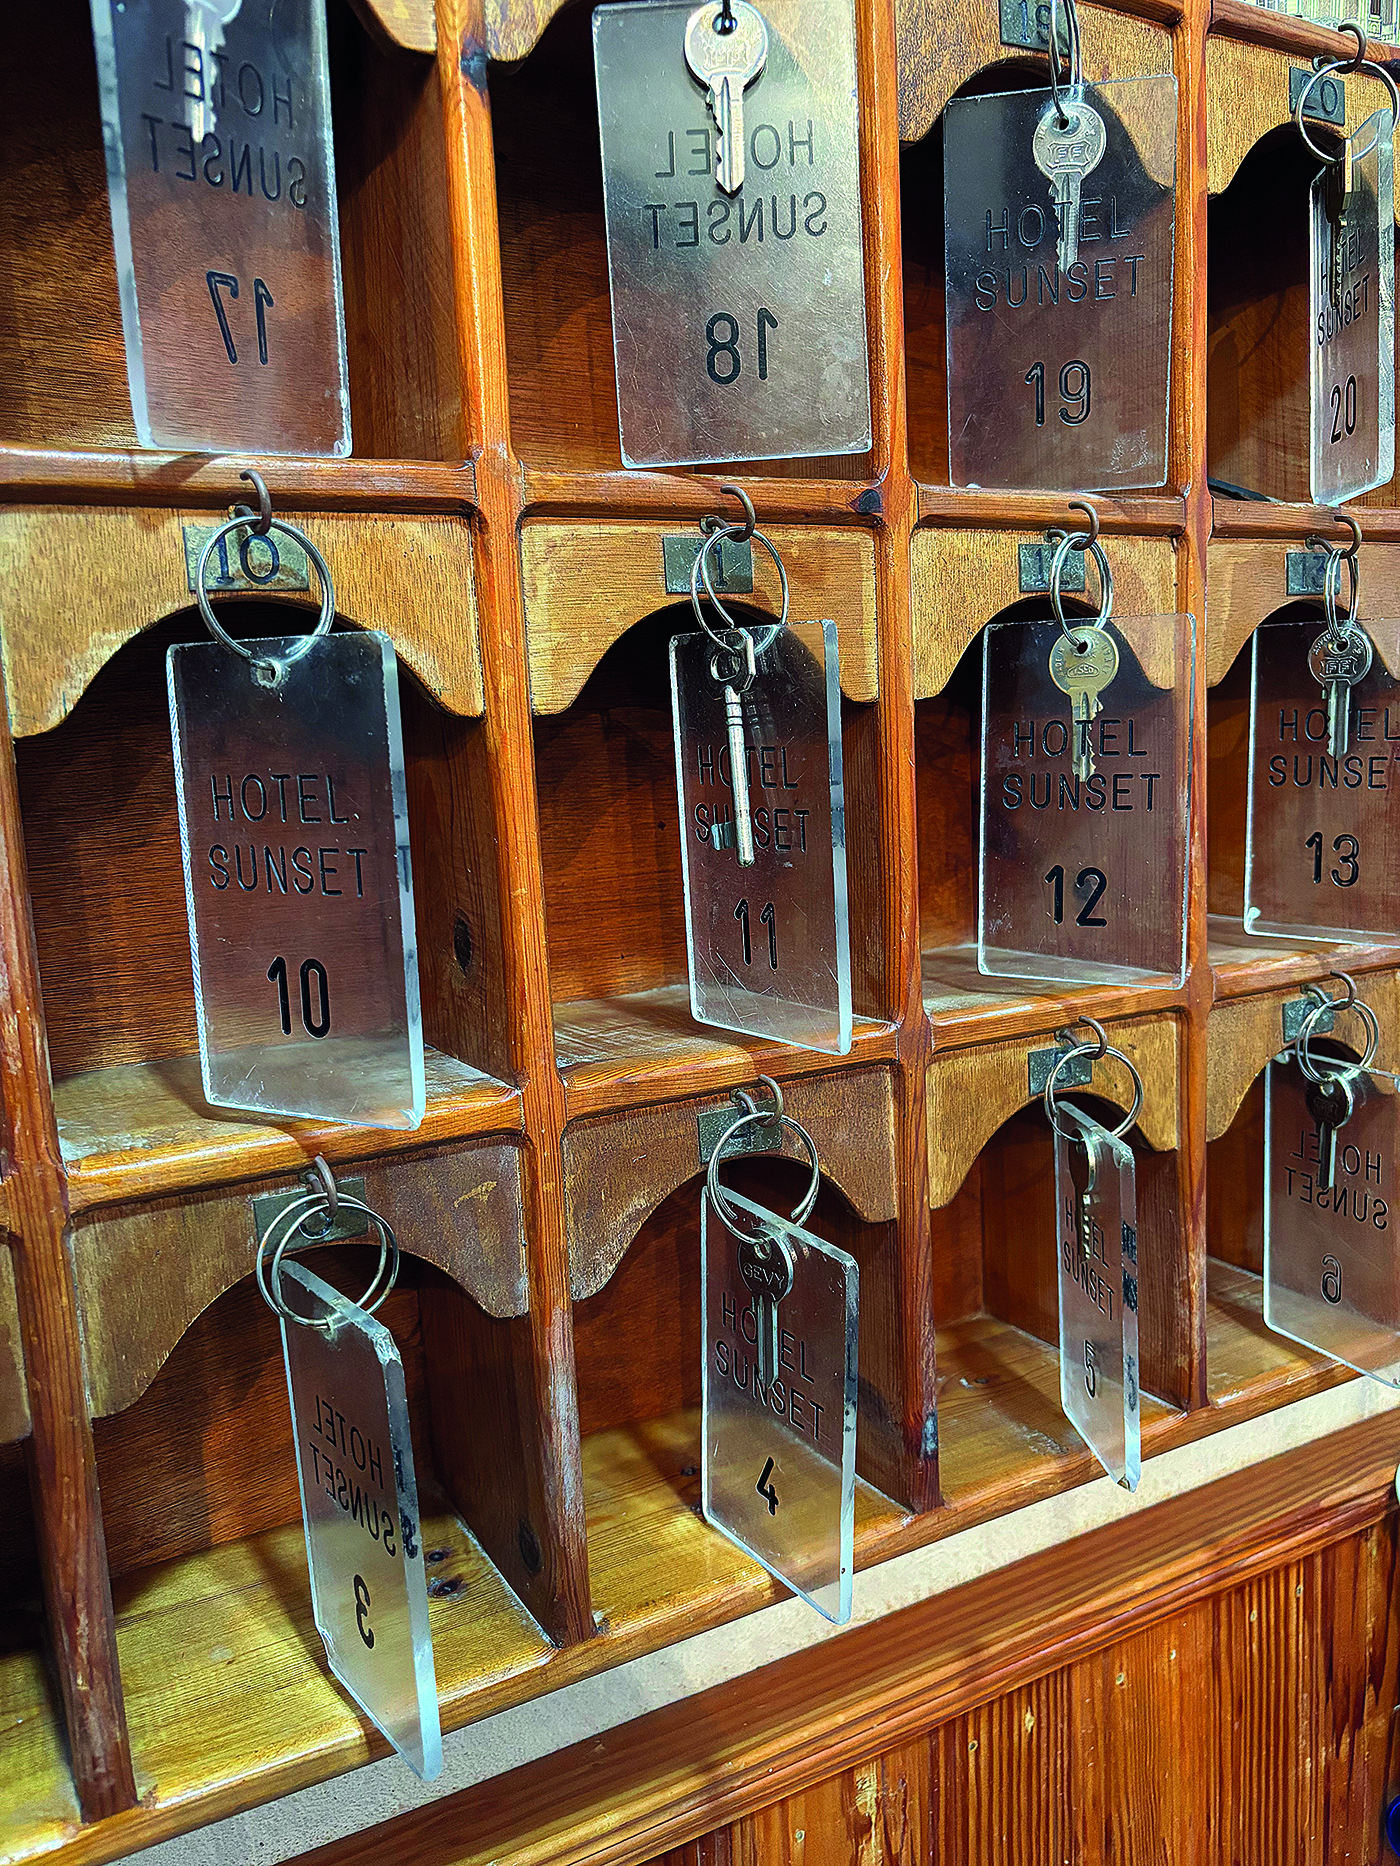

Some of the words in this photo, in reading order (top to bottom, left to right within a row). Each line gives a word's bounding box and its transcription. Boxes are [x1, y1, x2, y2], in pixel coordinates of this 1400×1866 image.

[986, 195, 1131, 252] HOTEL
[975, 254, 1146, 312] SUNSET
[1320, 227, 1366, 296] HTEL
[1317, 273, 1371, 346] SUNSET
[1024, 359, 1092, 427] 19
[1329, 373, 1357, 444] 20
[214, 531, 280, 586] 10
[1013, 718, 1148, 757] HOTEL
[1278, 707, 1400, 742] HOEL
[210, 773, 350, 824] HOTEL
[1002, 772, 1161, 812] SUNSET
[208, 843, 368, 898] SUNSET
[1305, 831, 1360, 888] 13
[1044, 864, 1108, 928] 12
[734, 898, 779, 971] 11
[266, 956, 331, 1039] 10
[1064, 1196, 1110, 1270] HEL
[1063, 1240, 1115, 1322] SUNSET
[721, 1291, 815, 1384] HOEL
[715, 1339, 825, 1441] SUNSET
[1083, 1339, 1096, 1400] 5
[756, 1456, 780, 1516] 4
